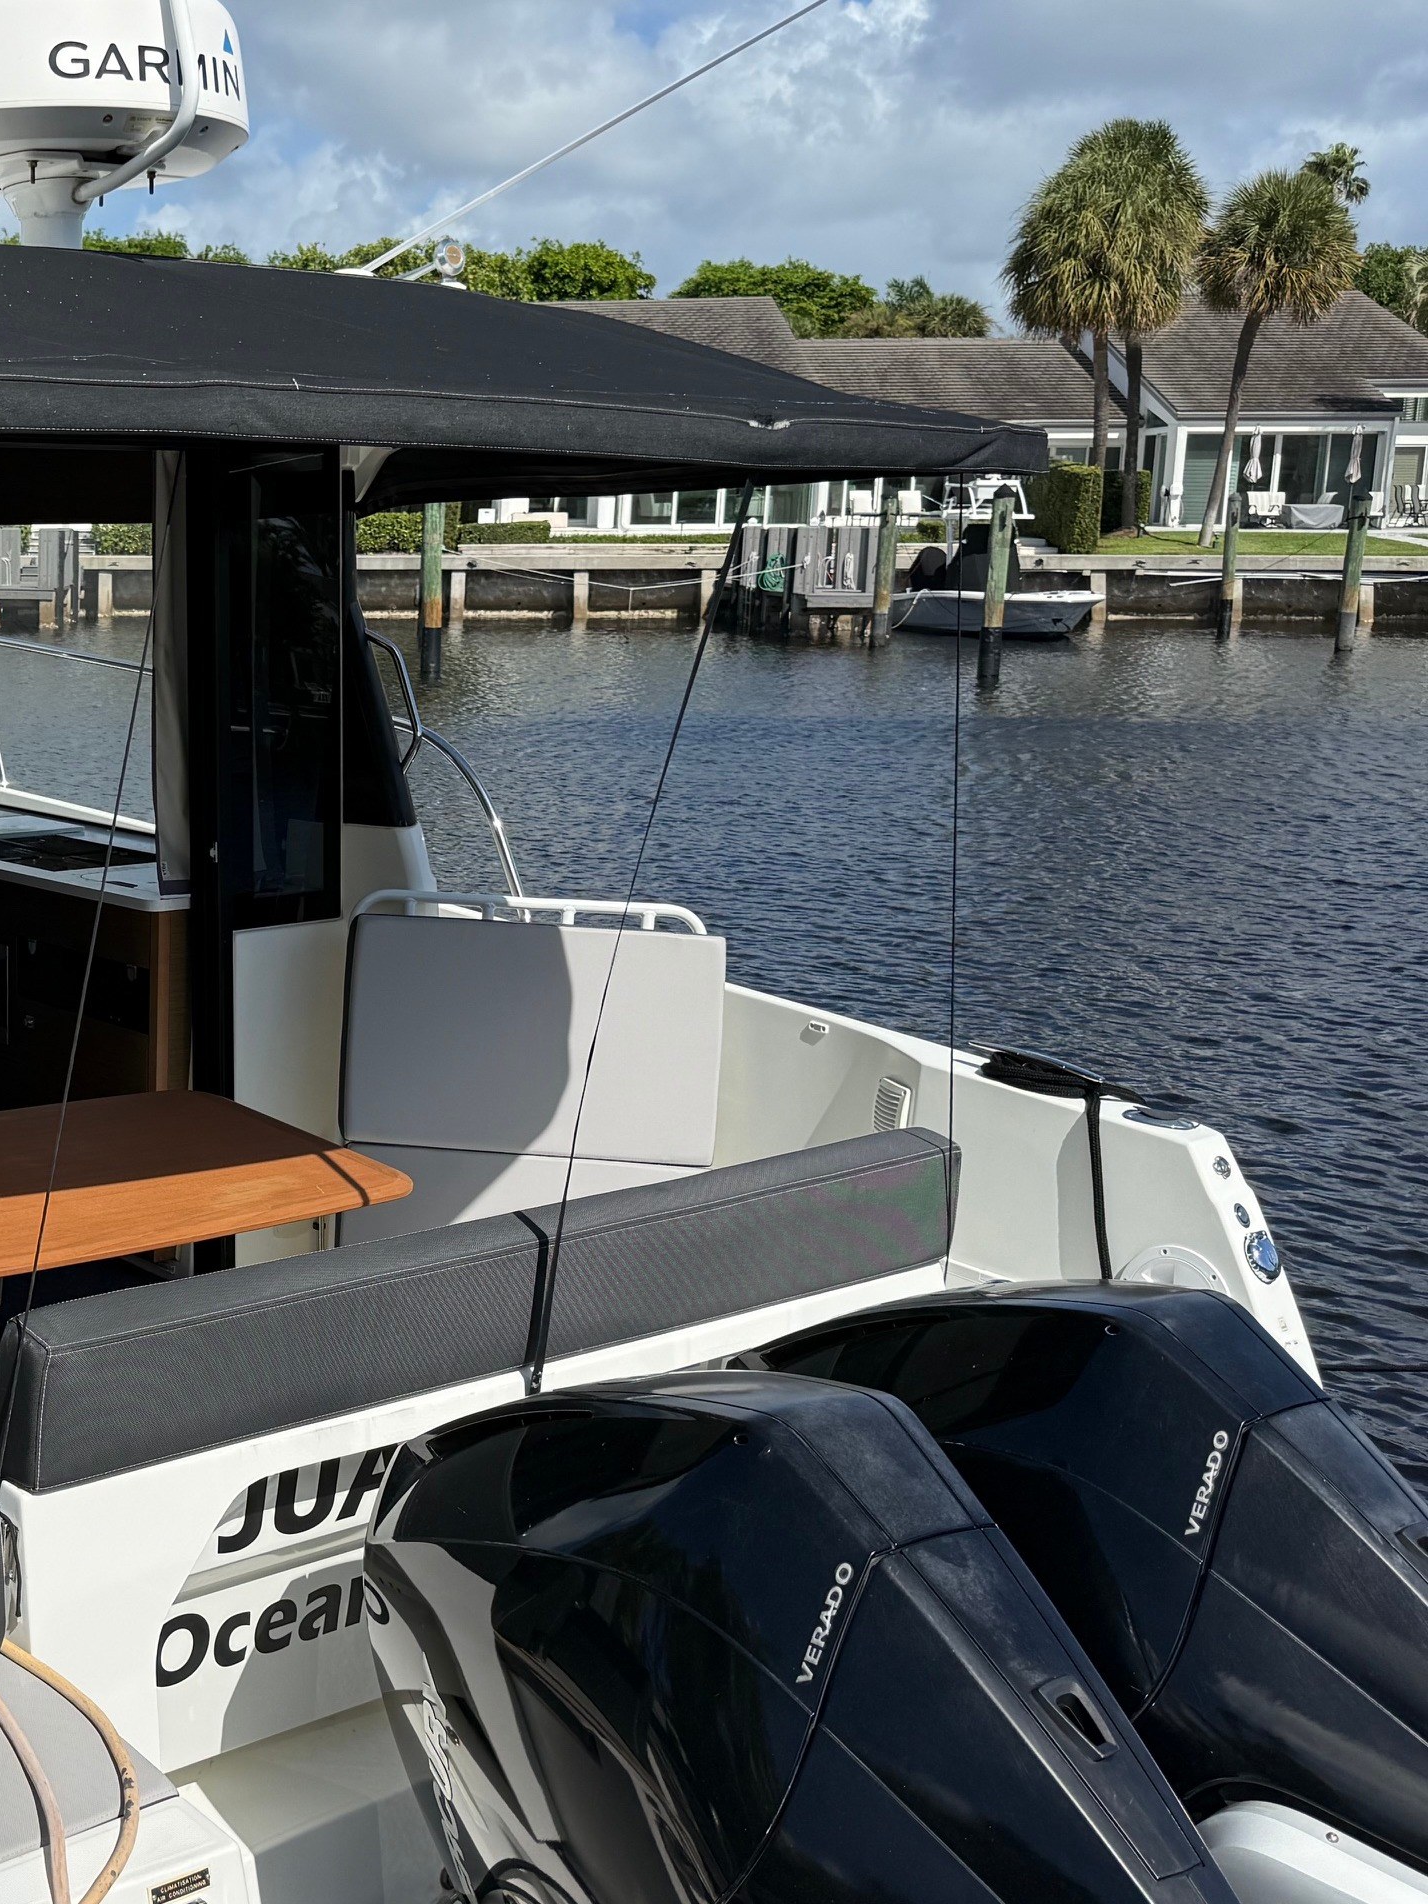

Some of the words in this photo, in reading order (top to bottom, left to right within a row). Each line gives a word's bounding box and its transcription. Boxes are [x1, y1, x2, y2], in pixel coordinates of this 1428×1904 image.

[1184, 1429, 1229, 1536] VERADO
[795, 1561, 853, 1684] VERADO
[157, 1895, 166, 1903] AIR
[168, 1879, 207, 1899] CONDITIONING
[160, 1874, 202, 1894] CLIMATISATION
